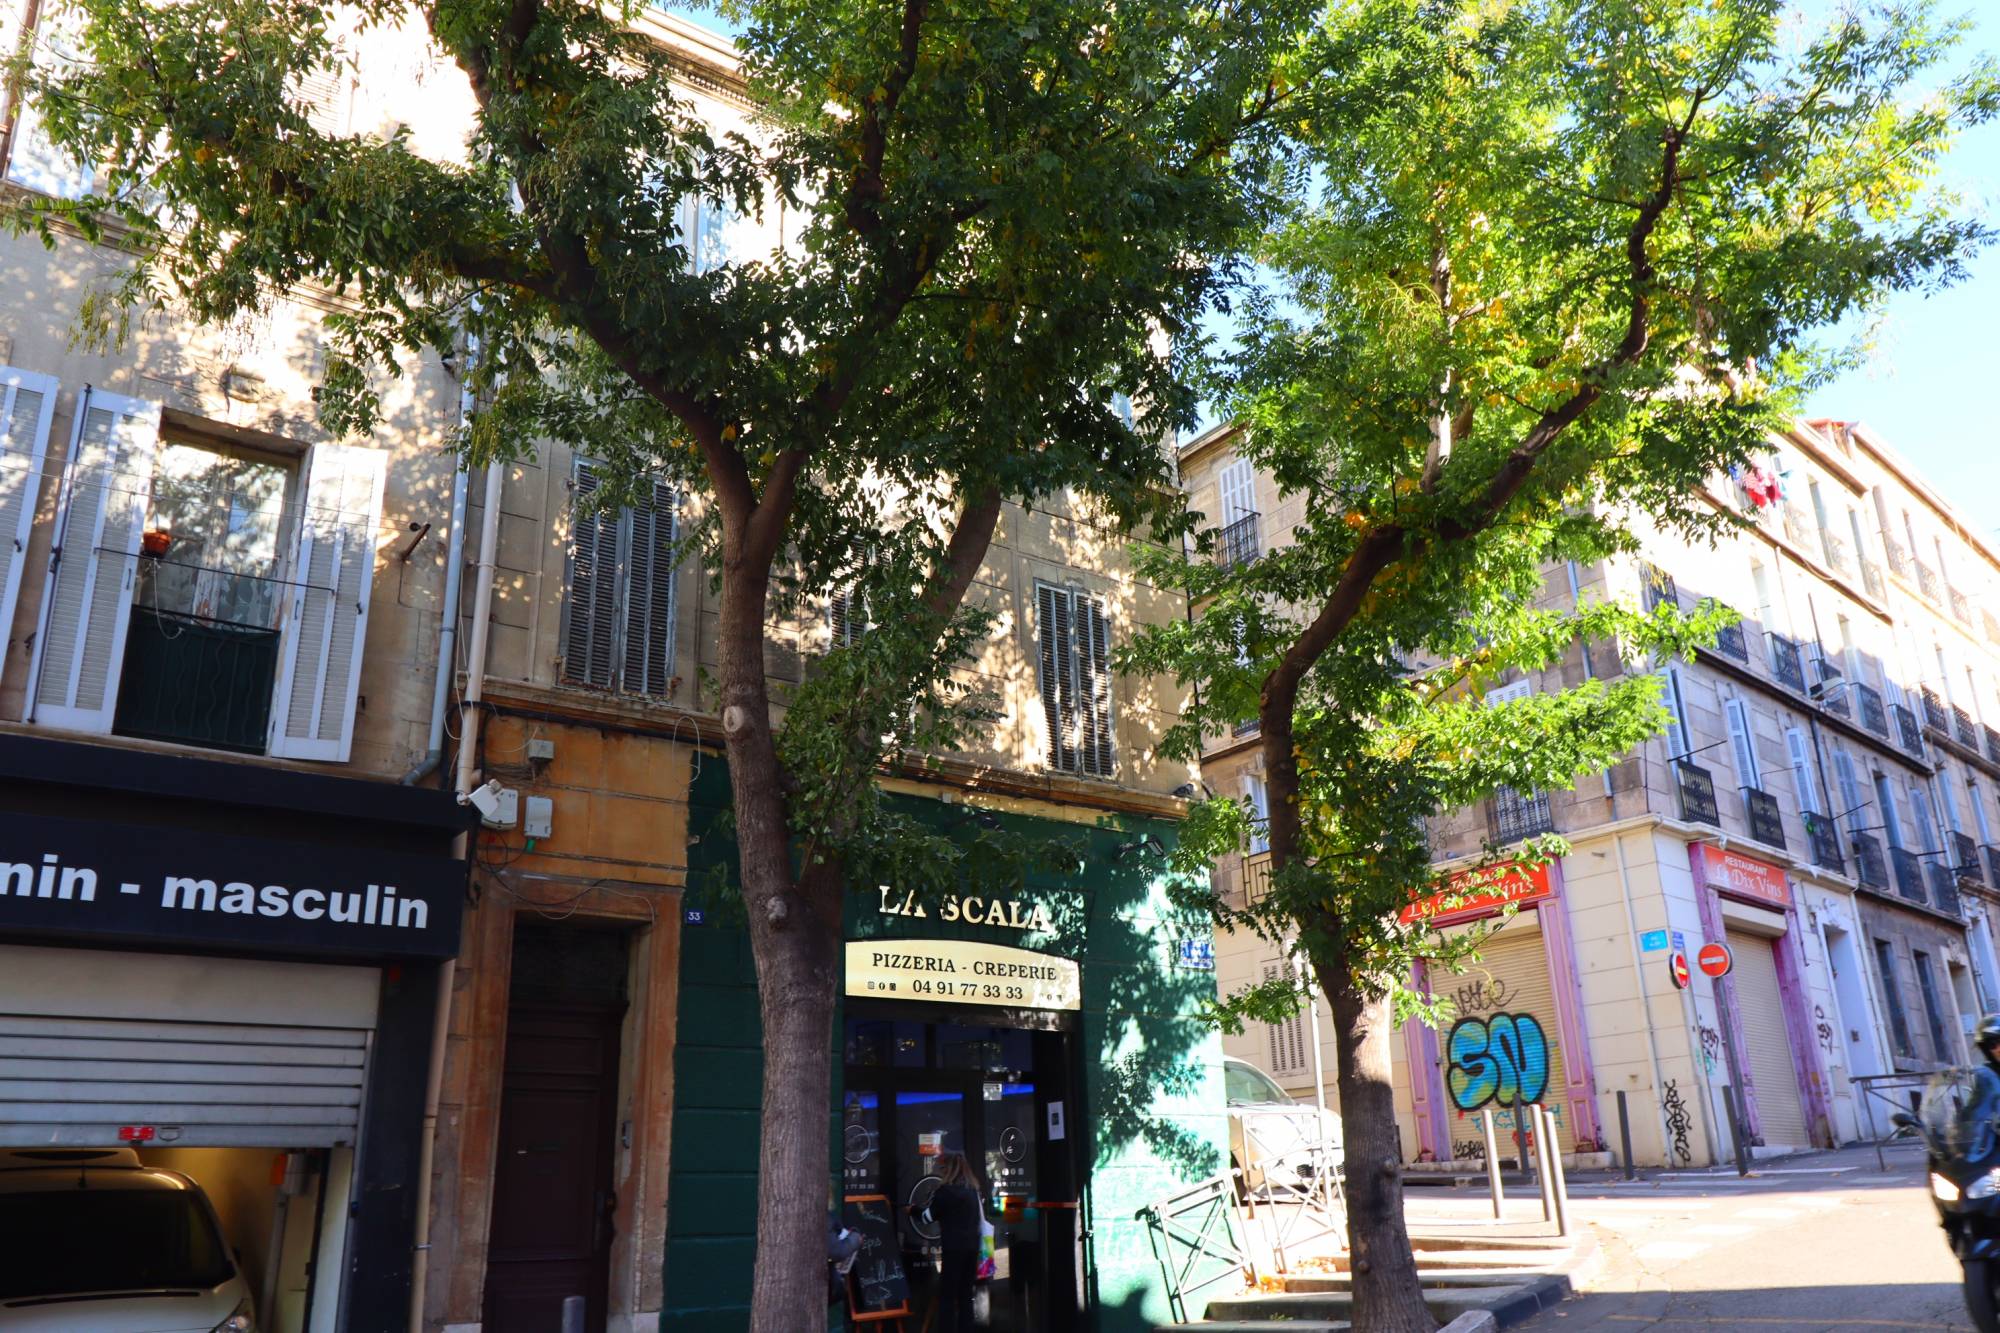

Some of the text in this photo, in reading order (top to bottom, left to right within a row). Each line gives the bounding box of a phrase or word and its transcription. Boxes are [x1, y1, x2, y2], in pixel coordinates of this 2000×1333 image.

[1724, 855, 1769, 876] RESTAURANT
[1731, 868, 1757, 890] Dix
[1756, 876, 1783, 898] Vins
[161, 876, 429, 929] masculin
[688, 911, 701, 921] 33
[879, 885, 1051, 933] LA SCALA
[872, 952, 956, 973] PIZZERIA
[973, 960, 1058, 980] CREPERIE
[912, 979, 1023, 1000] 04 91 77 33 33
